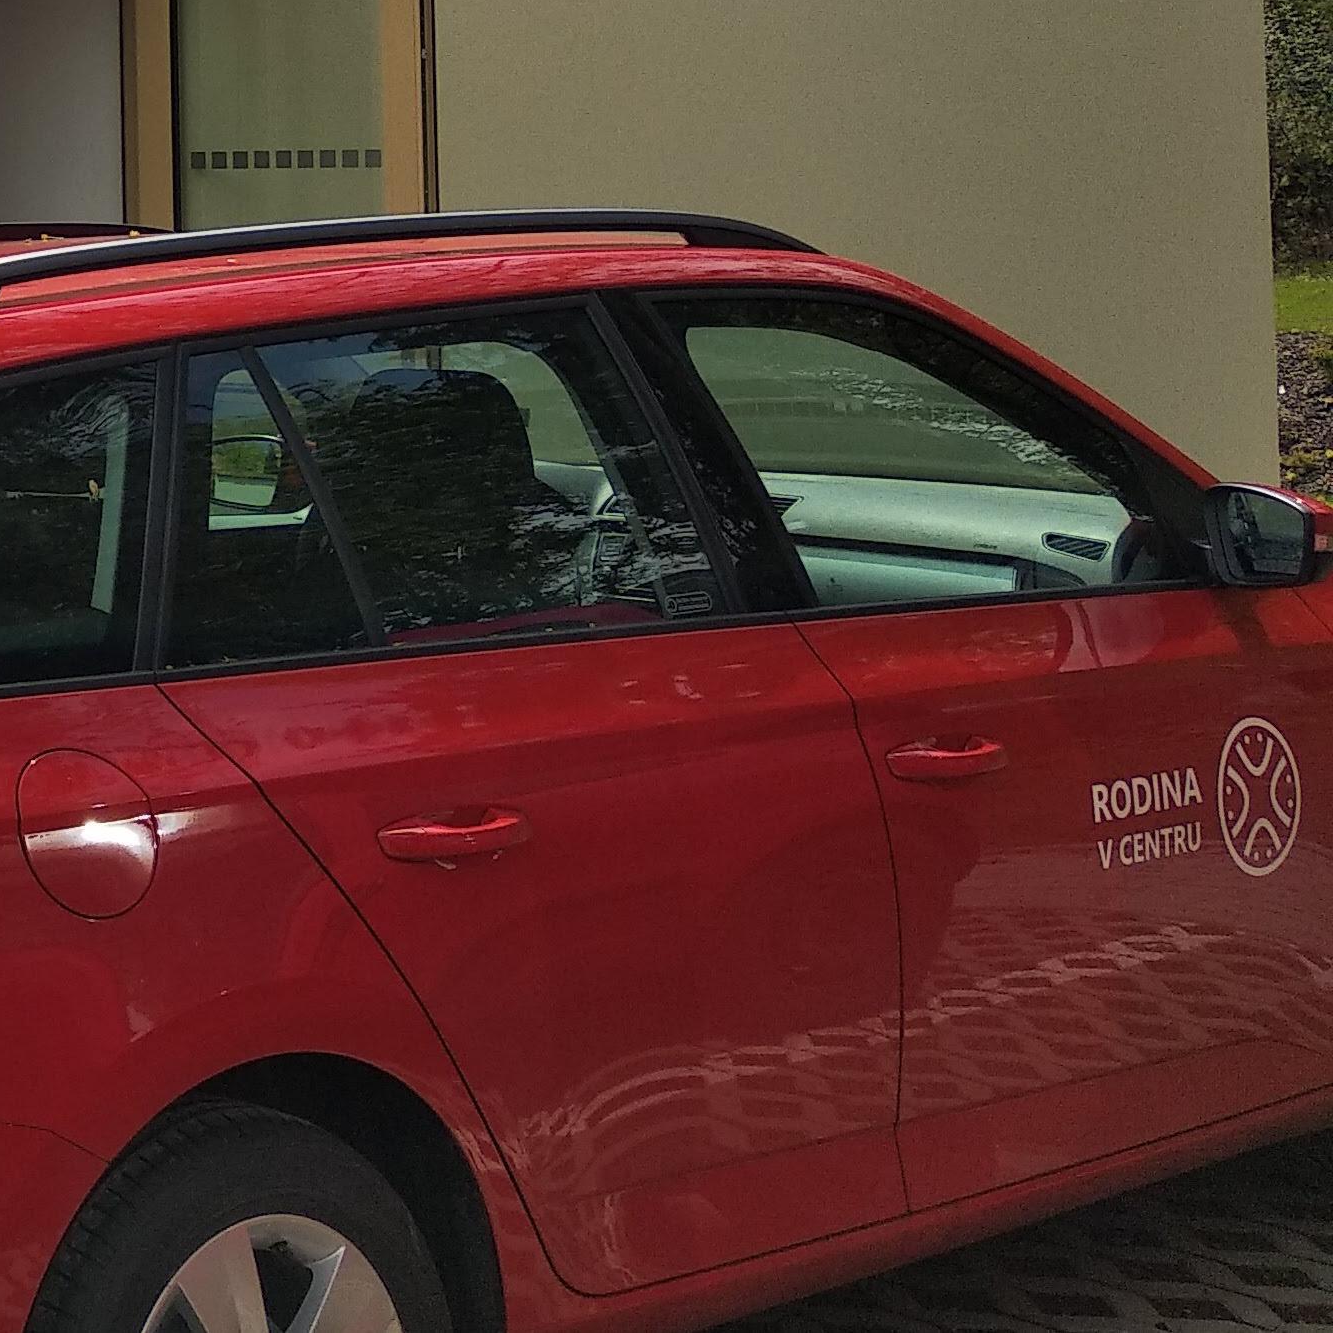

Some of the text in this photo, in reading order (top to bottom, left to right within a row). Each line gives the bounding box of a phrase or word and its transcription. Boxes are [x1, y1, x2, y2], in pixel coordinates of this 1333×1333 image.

[1091, 767, 1203, 823] RODINA
[1097, 821, 1202, 870] V CENTRU
